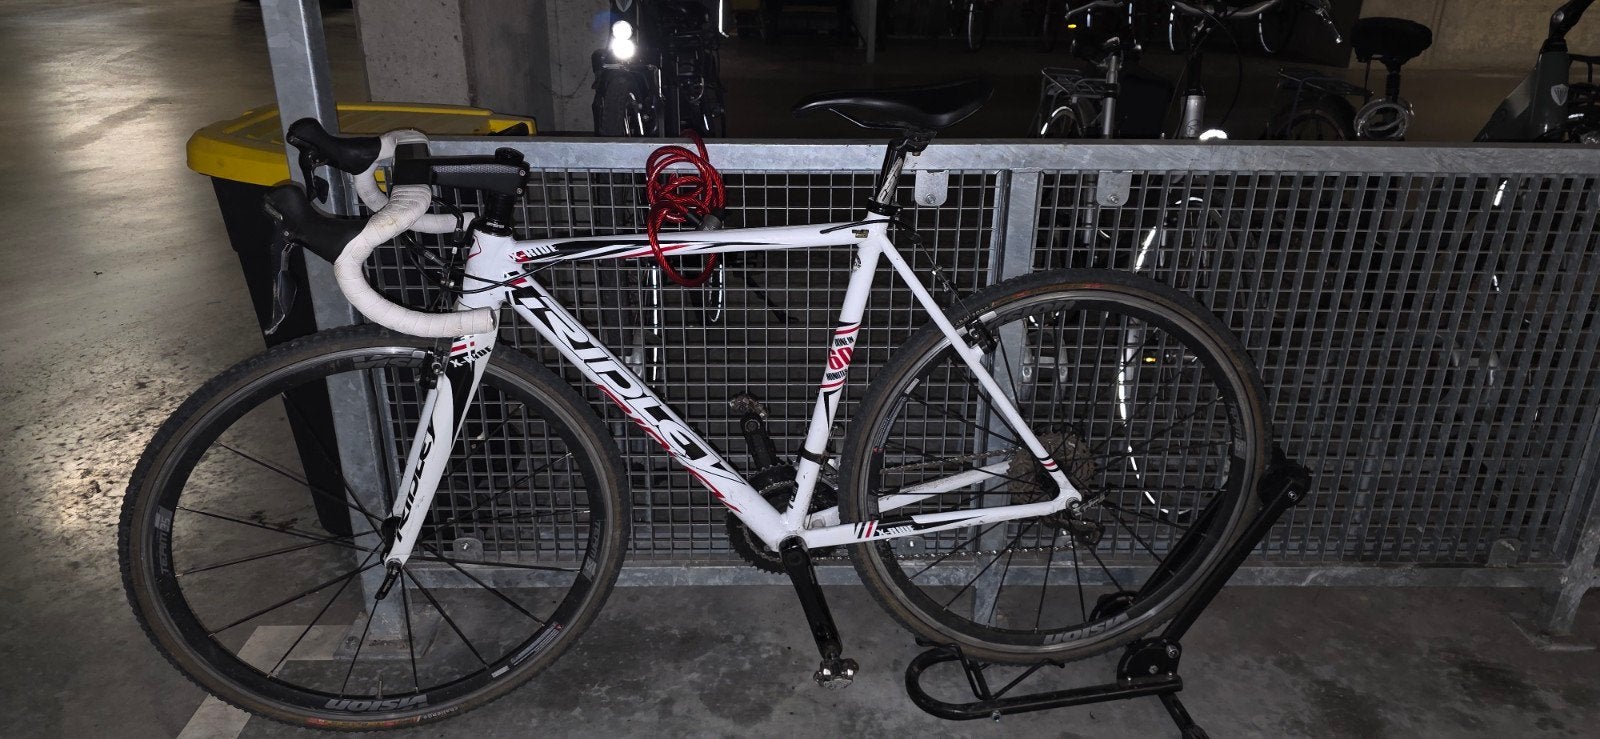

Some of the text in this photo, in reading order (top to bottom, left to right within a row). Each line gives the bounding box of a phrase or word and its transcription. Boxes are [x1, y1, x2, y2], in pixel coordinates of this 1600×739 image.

[510, 245, 560, 260] X-RIDE
[450, 346, 492, 368] X-RIDE
[829, 347, 853, 370] 60
[511, 286, 748, 484] RIDLEY
[396, 412, 436, 543] RIDLEY
